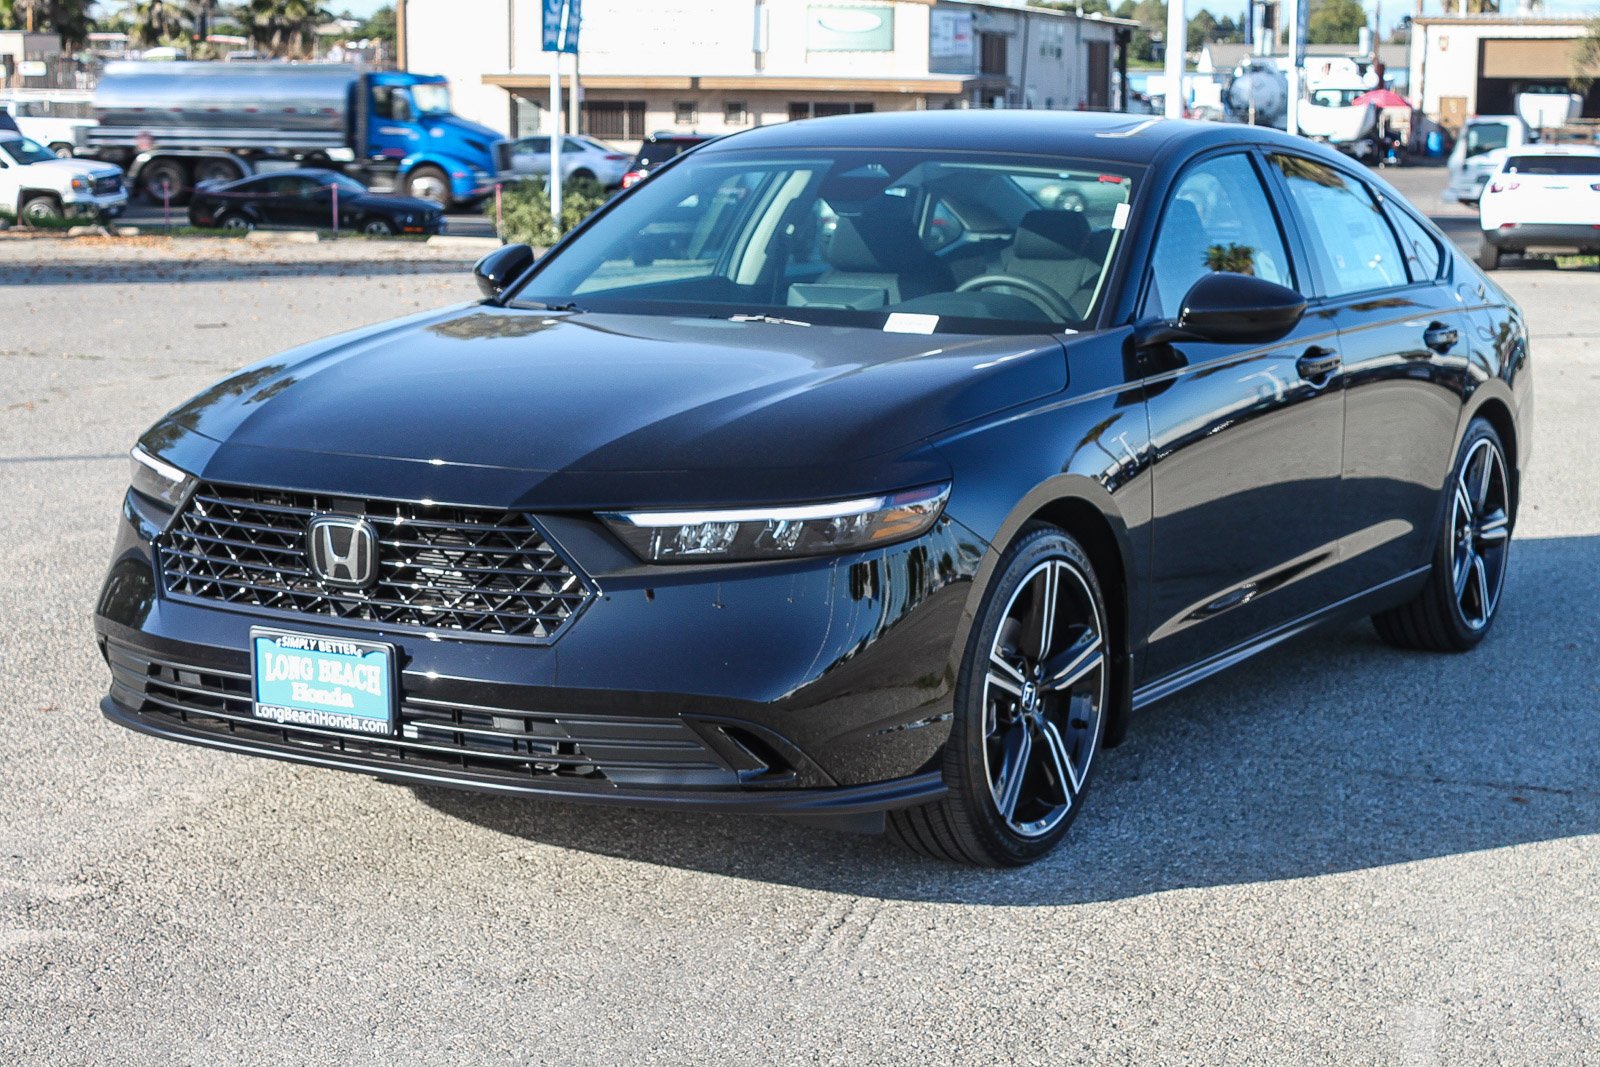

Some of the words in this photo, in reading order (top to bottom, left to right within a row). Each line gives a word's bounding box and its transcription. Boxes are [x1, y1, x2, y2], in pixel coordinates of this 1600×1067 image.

[281, 636, 317, 651] SIMPLY
[318, 640, 358, 656] BETTER
[265, 652, 314, 682] LONG
[318, 658, 381, 696] BEACH
[292, 682, 354, 708] Honda
[255, 702, 388, 734] LongBeachHonda.com
